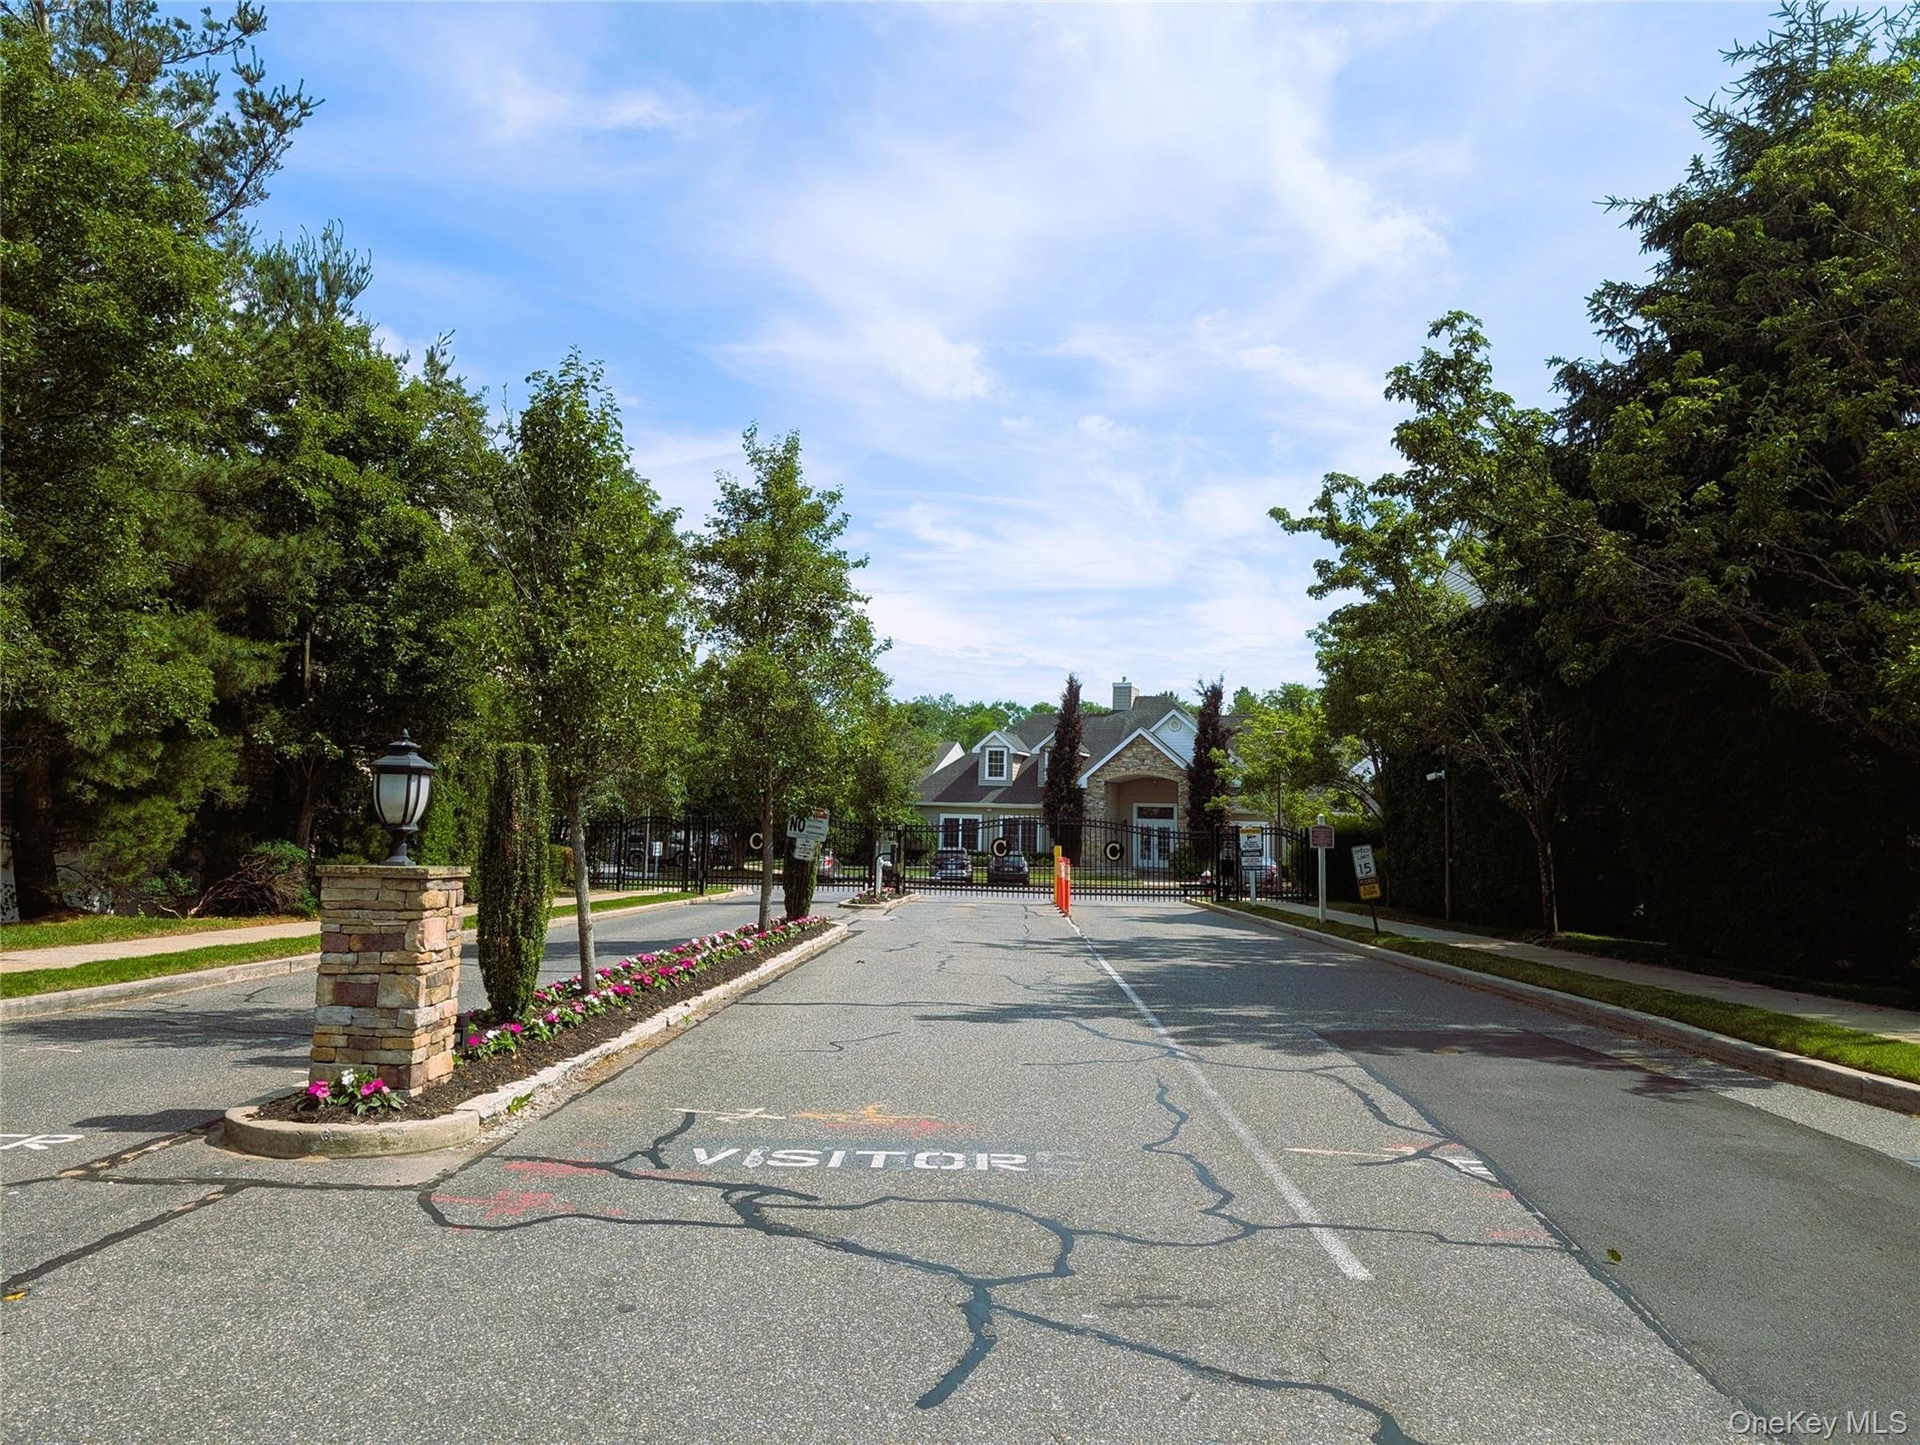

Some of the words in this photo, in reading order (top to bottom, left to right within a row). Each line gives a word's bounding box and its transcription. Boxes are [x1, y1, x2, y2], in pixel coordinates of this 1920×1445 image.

[789, 815, 806, 833] NO
[749, 832, 764, 850] C
[992, 839, 1008, 858] C
[1106, 842, 1121, 861] C
[1358, 862, 1372, 875] 15
